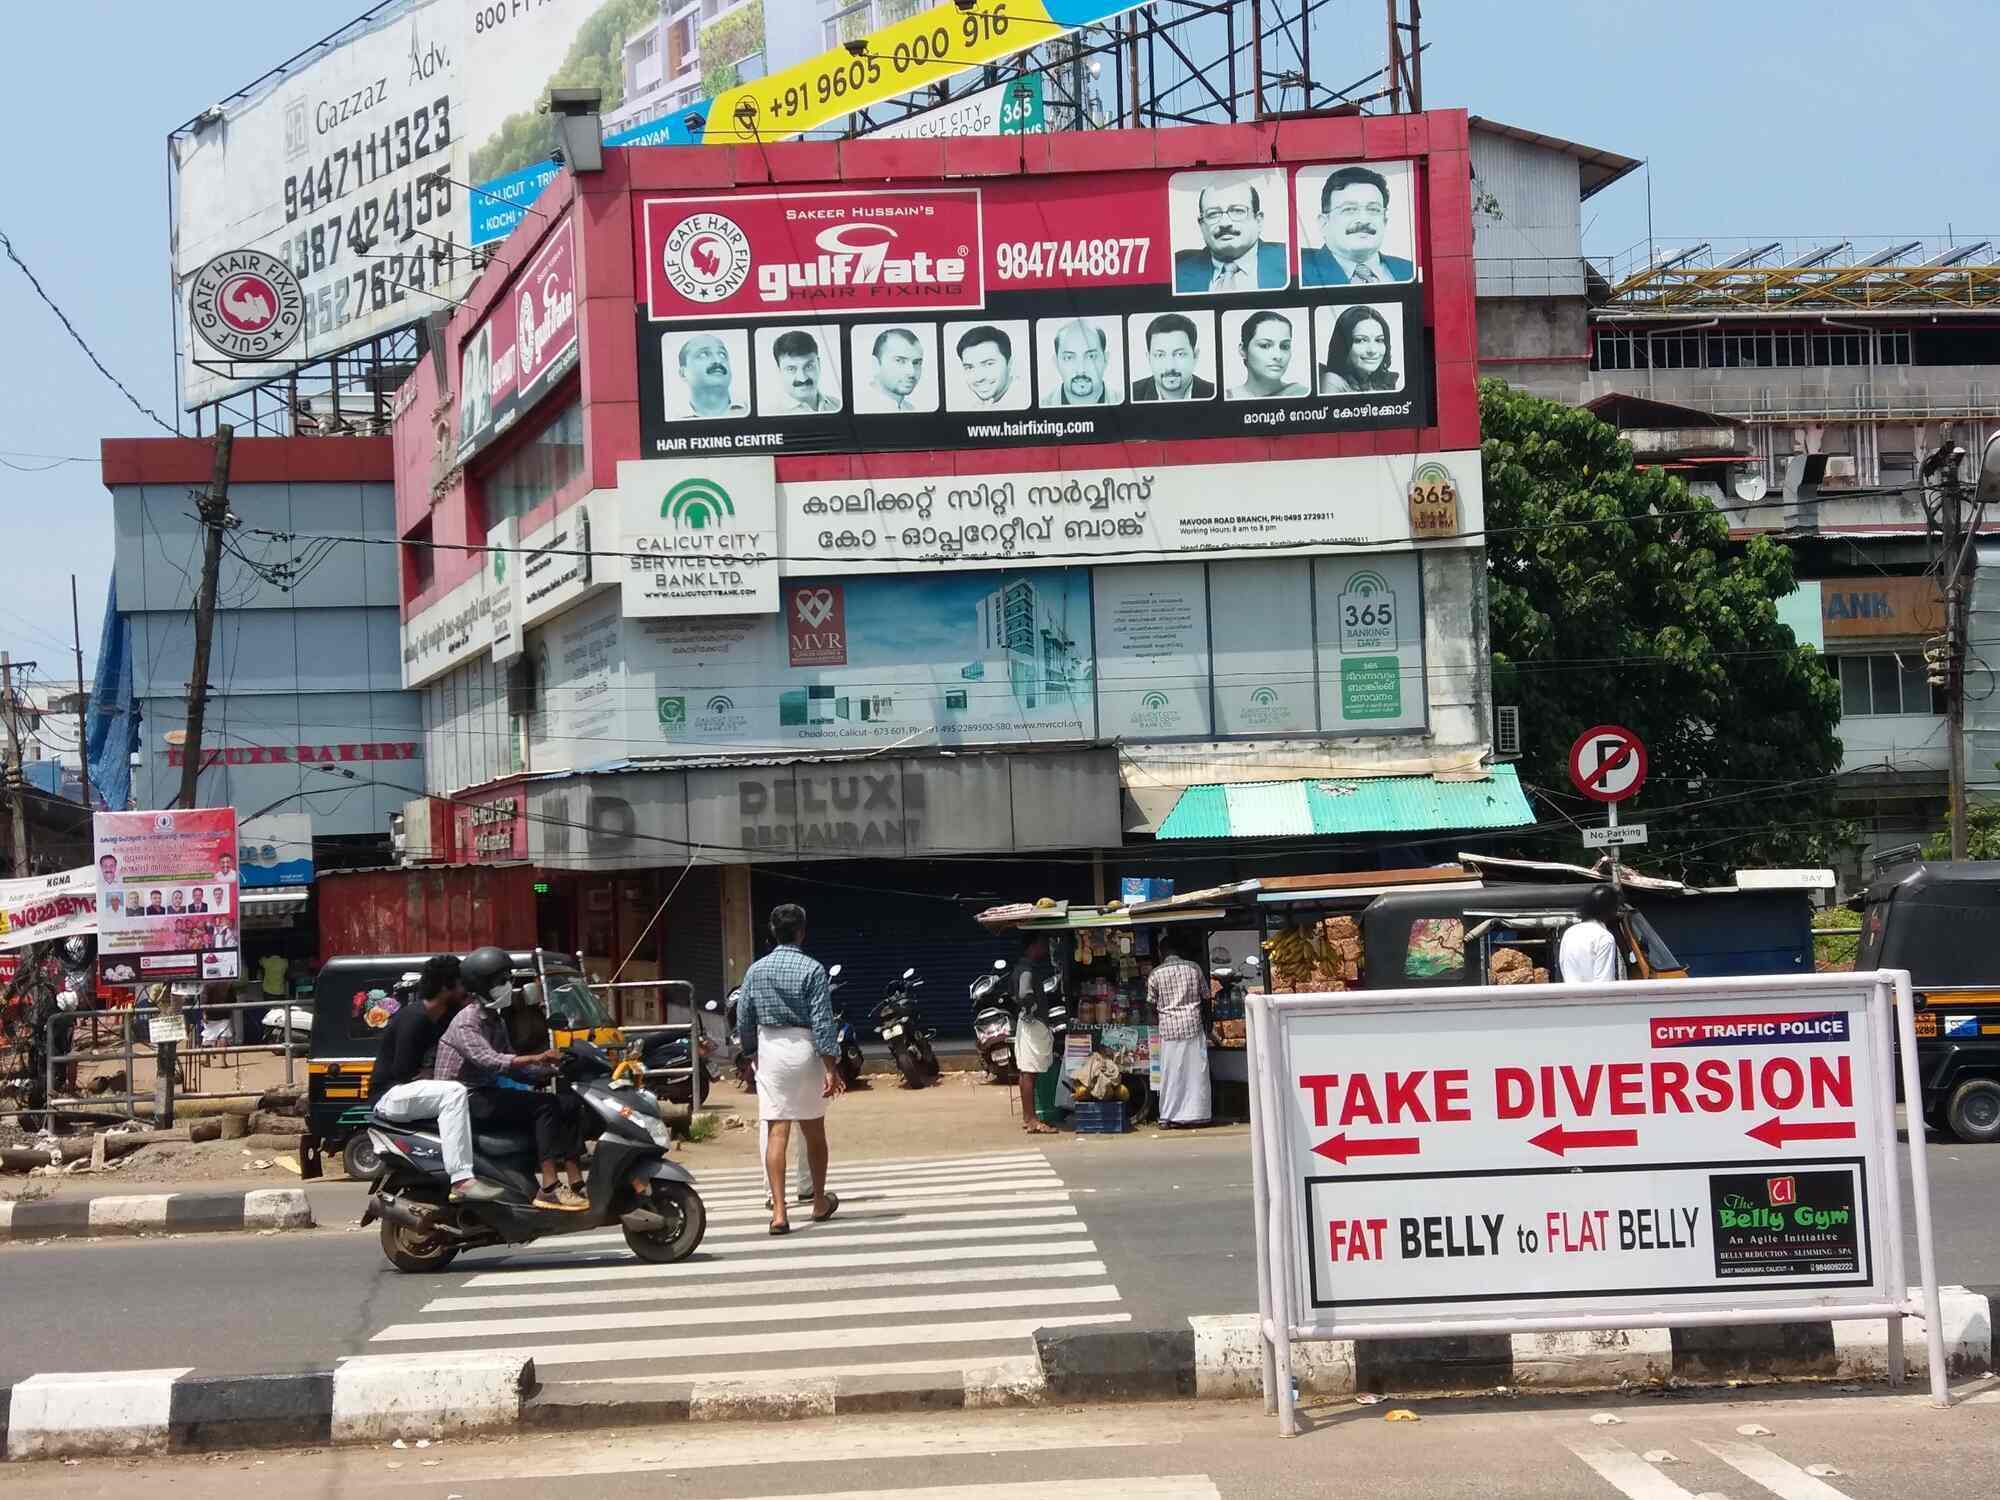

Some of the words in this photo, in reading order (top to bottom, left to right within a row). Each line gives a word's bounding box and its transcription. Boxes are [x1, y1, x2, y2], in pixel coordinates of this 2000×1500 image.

[475, 2, 506, 34] 800
[770, 84, 810, 120] +91
[817, 51, 880, 106] 9605
[894, 29, 949, 73] 000
[962, 4, 1009, 48] 916
[315, 76, 388, 136] Gazzaz
[408, 40, 451, 87] Adv.
[950, 103, 983, 125] CITY
[1003, 97, 1032, 123] 365
[284, 94, 451, 224] 9447111323
[485, 180, 526, 206] CALICUT
[486, 210, 516, 232] KOCHI
[708, 216, 742, 245] HAIR
[669, 217, 702, 252] GATE
[212, 255, 260, 278] HAIR
[996, 237, 1151, 281] 9847448877
[666, 259, 695, 294] GULF
[714, 249, 748, 297] FIXING
[196, 277, 217, 329] GATE
[264, 263, 299, 326] FIXING
[789, 287, 856, 300] HAIR
[870, 284, 962, 298] FIXING
[216, 333, 269, 353] GULF
[967, 420, 1095, 441] www.hairfixing.com
[656, 437, 688, 451] HAIR
[692, 436, 735, 449] FIXING
[737, 433, 784, 447] CENTRE
[1413, 485, 1453, 505] 365
[1179, 518, 1213, 526] MAVOOR
[1214, 517, 1235, 525] ROAD
[1180, 526, 1209, 536] Working
[636, 535, 714, 551] CALICUT
[718, 533, 760, 549] CITY
[630, 554, 706, 570] SERVICE
[655, 573, 705, 587] BANK
[709, 571, 744, 585] LTD.
[1345, 603, 1392, 626] 365
[791, 632, 844, 650] MVR
[1346, 628, 1390, 638] BANKING
[296, 742, 418, 764] BAKERY
[1590, 831, 1604, 839] No
[1608, 829, 1641, 838] Parking
[1656, 1024, 1698, 1041] CITY
[1701, 1021, 1778, 1038] TRAFFIC
[1780, 1019, 1844, 1035] POLICE
[1299, 1069, 1472, 1127] TAKE
[1495, 1055, 1854, 1120] DIVERSION
[1723, 1193, 1754, 1210] The
[1719, 1208, 1786, 1232] Belly
[1793, 1206, 1849, 1231] Gym
[1328, 1218, 1388, 1263] FAT
[1400, 1213, 1504, 1259] BELLY
[1517, 1223, 1539, 1254] to
[1546, 1209, 1610, 1254] FLAT
[1618, 1206, 1699, 1251] BELLY
[1728, 1235, 1744, 1245] An
[1750, 1234, 1778, 1245] Agile
[1784, 1233, 1839, 1243] Initiative
[1720, 1251, 1743, 1260] BELLY
[1745, 1250, 1788, 1259] REDUCTION
[1793, 1249, 1833, 1257] SLIMMING
[1838, 1248, 1853, 1256] SPA
